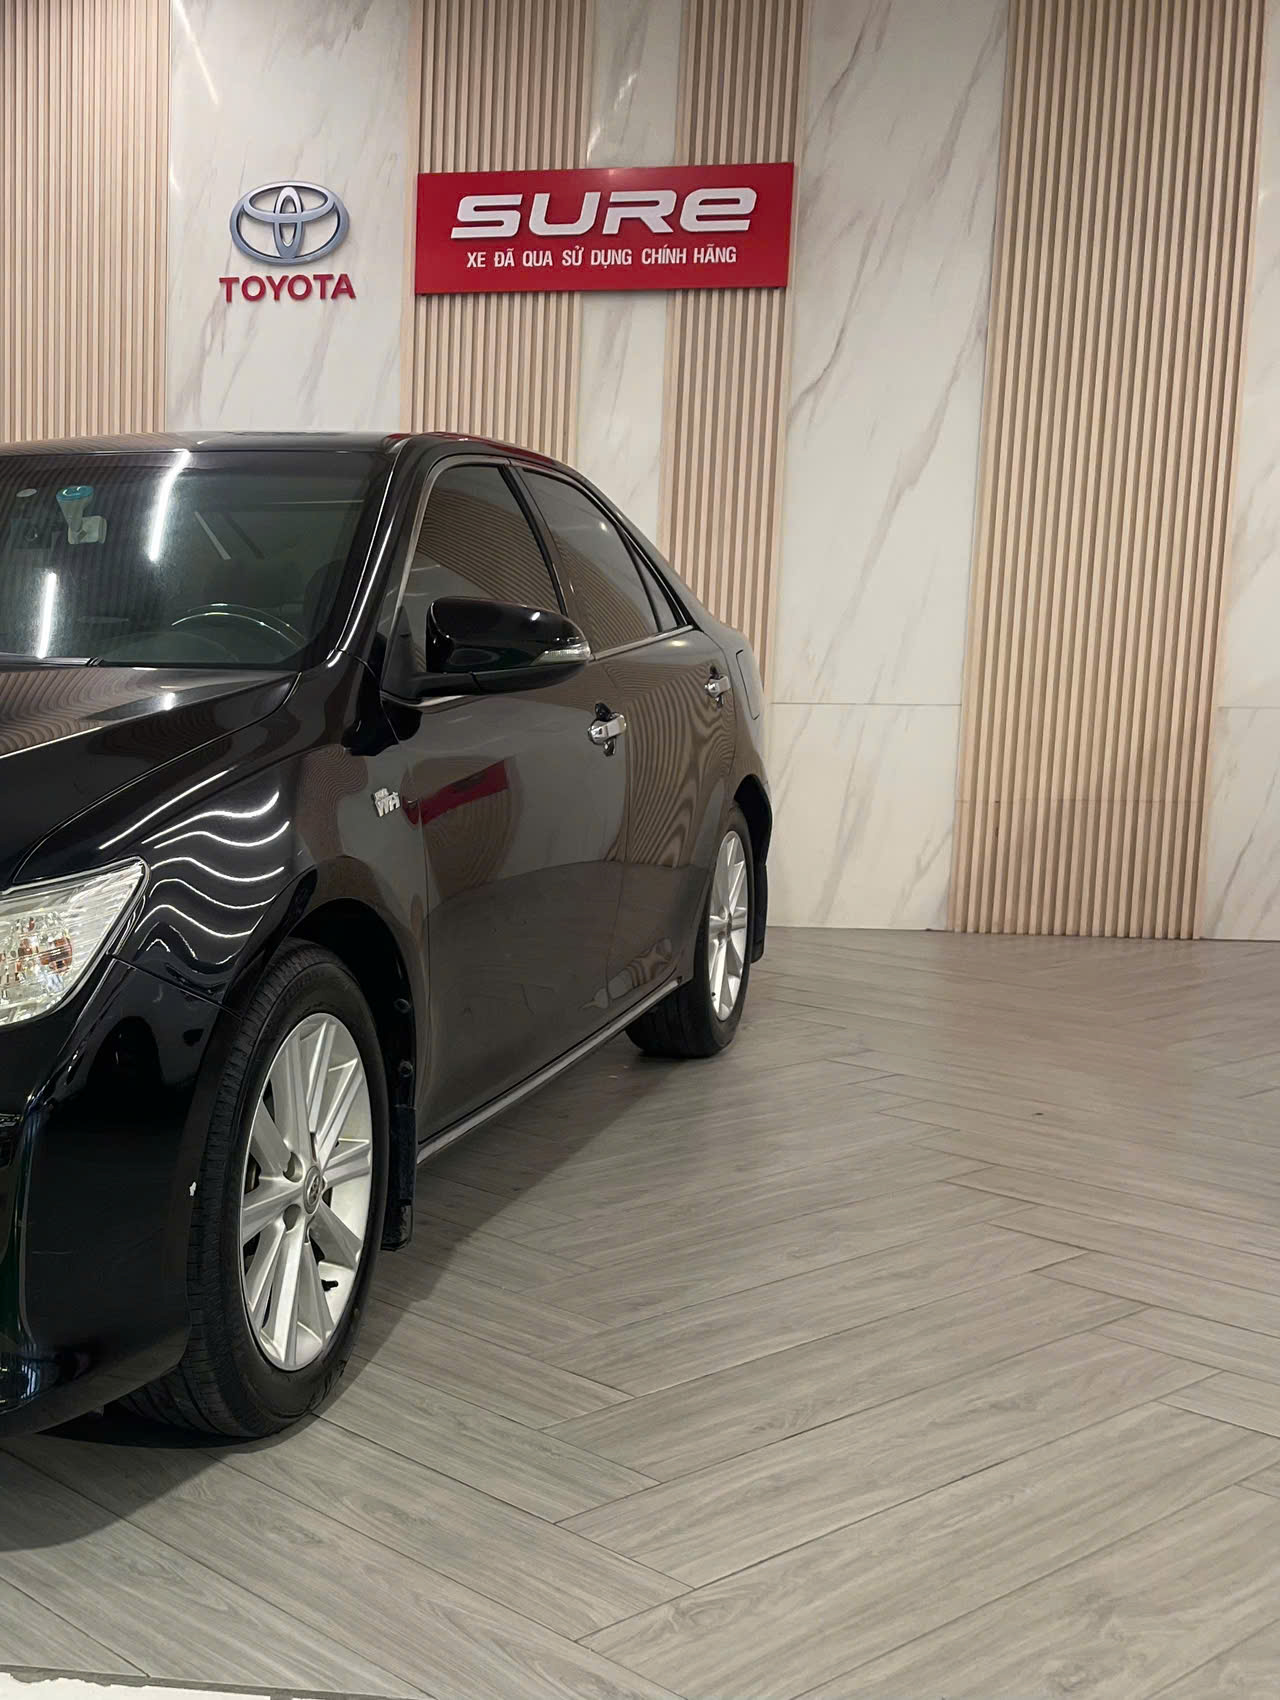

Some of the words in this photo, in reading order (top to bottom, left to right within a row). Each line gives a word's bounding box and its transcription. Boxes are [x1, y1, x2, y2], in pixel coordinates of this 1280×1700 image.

[466, 251, 487, 268] XE
[493, 248, 515, 268] ĐÃ
[522, 250, 553, 268] QUA
[561, 245, 585, 267] SỬ
[590, 248, 632, 269] DỤNG
[641, 244, 687, 265] CHÍNH
[693, 243, 737, 264] HÃNG
[219, 273, 356, 303] TOYOTA
